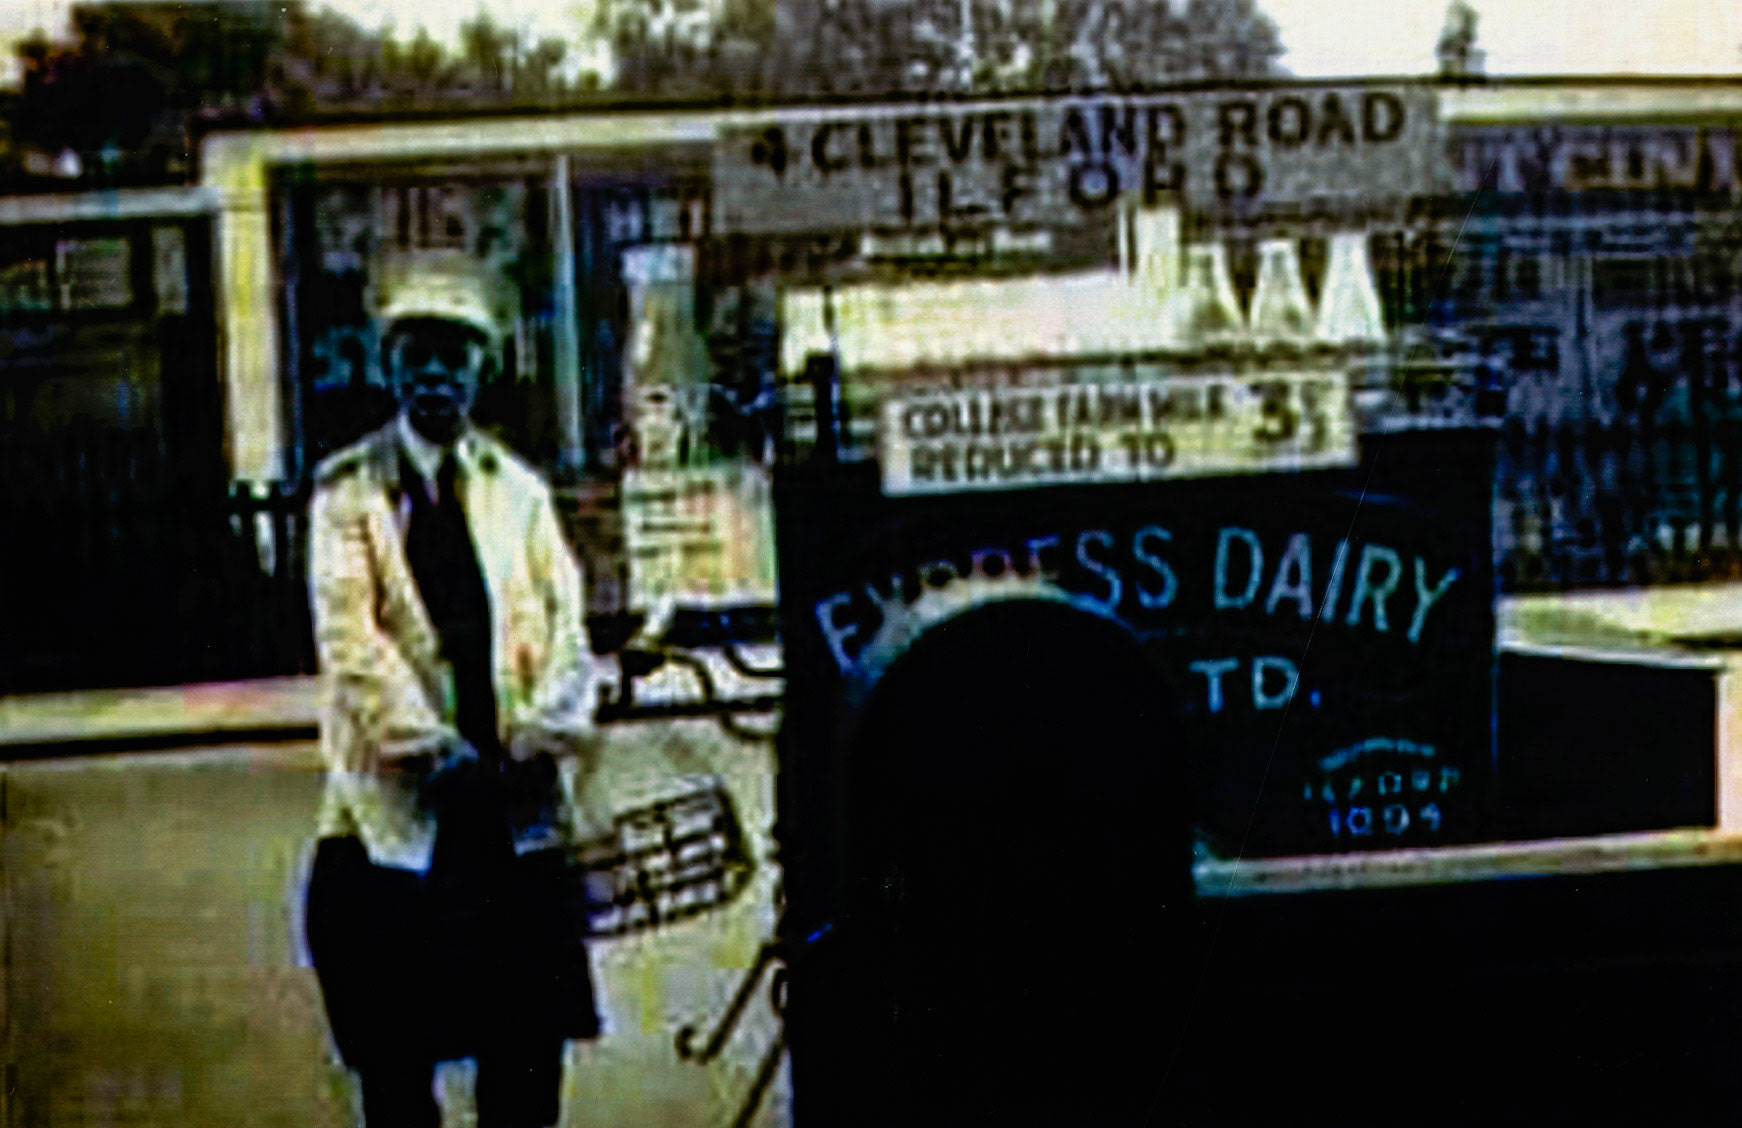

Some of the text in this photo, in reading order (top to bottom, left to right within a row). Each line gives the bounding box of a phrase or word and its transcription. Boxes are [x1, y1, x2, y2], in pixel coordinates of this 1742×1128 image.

[810, 102, 1187, 172] CLEVELAND
[1217, 91, 1405, 148] ROAD
[1212, 526, 1463, 643] DAIRY
[1187, 656, 1323, 713] TD.
